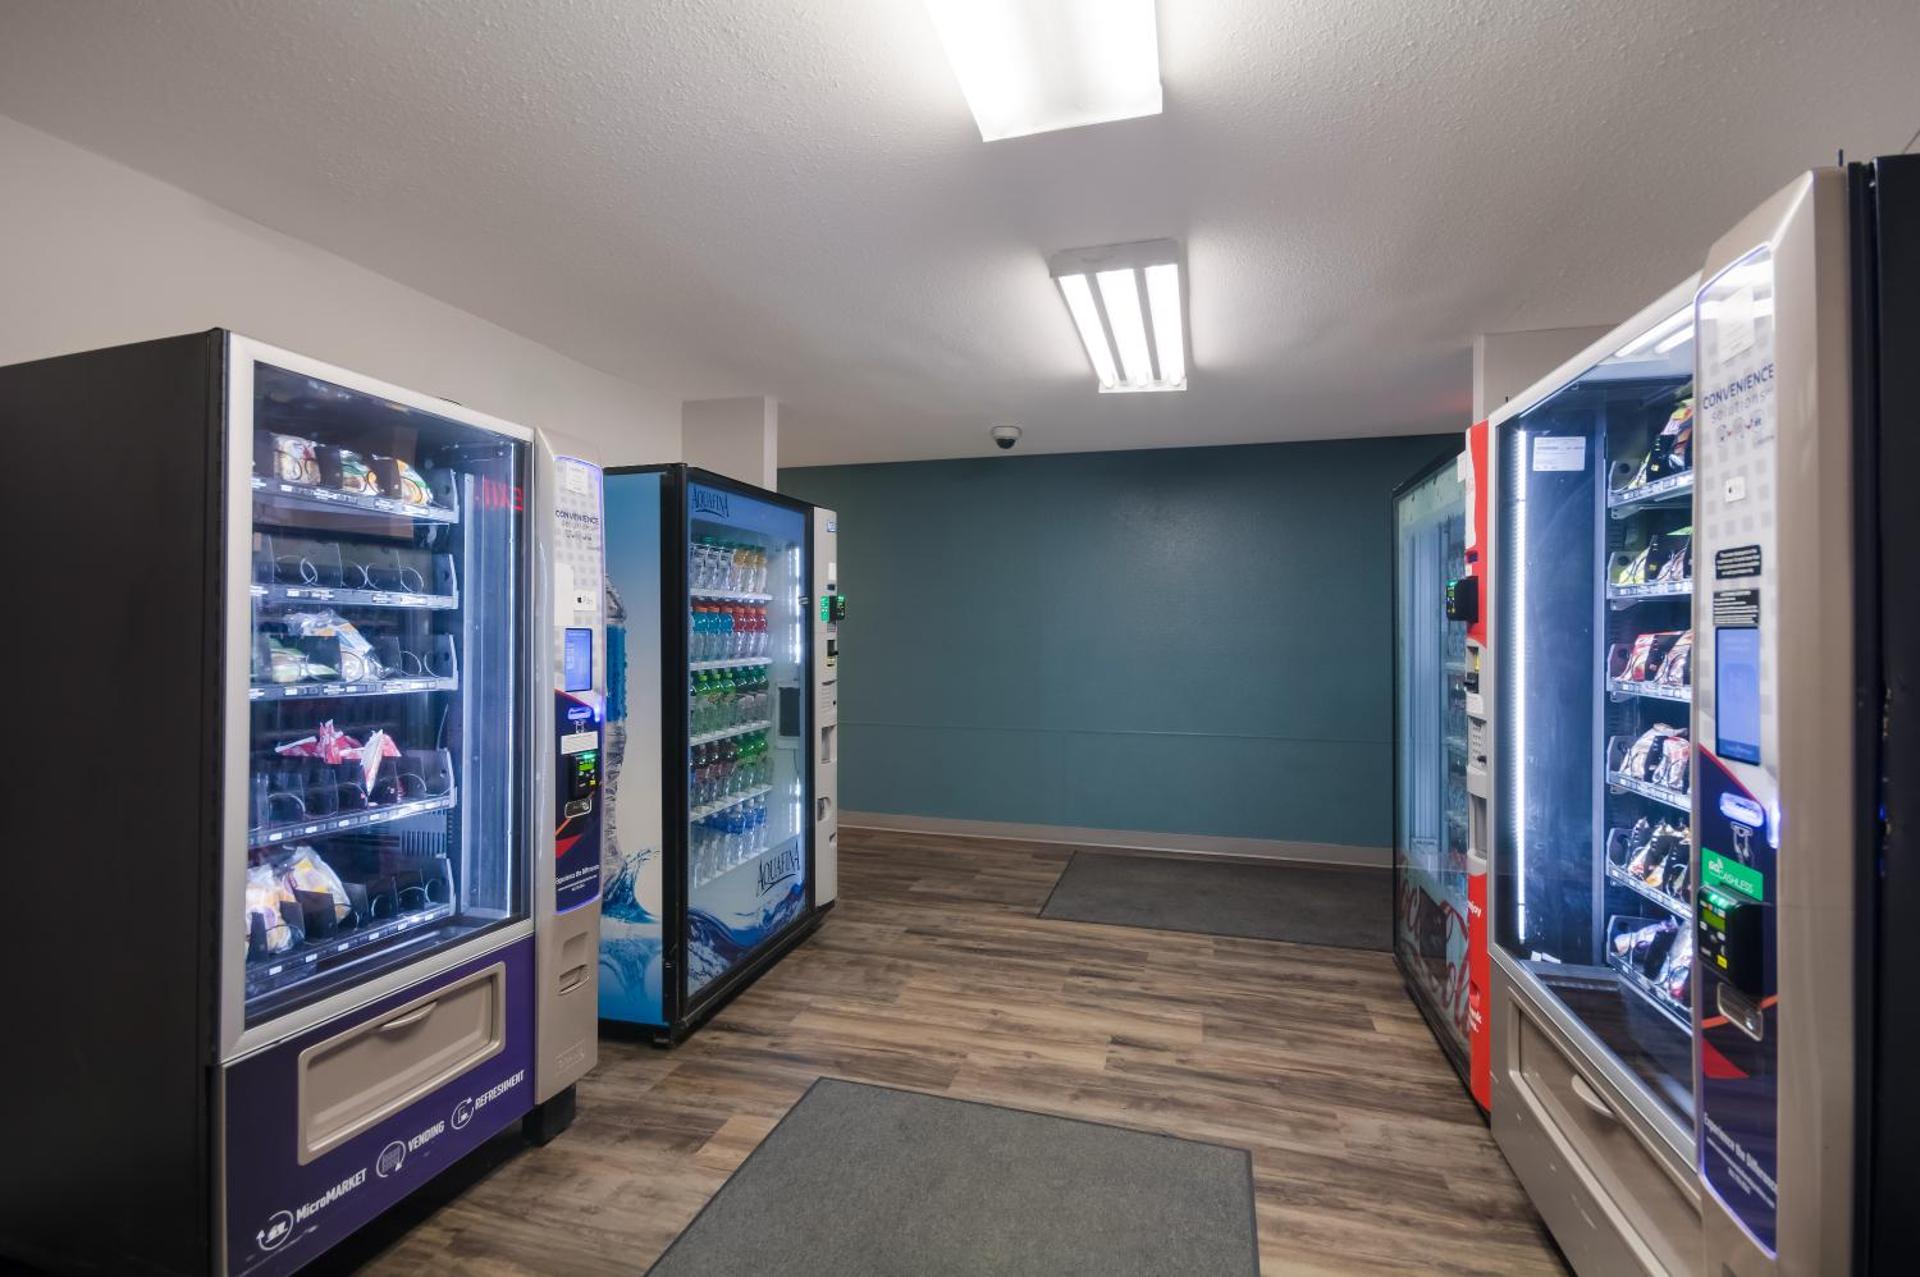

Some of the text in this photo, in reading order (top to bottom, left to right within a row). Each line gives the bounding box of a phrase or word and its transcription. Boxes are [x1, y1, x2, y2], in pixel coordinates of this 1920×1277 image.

[1702, 363, 1774, 410] CONVENIENCE
[555, 509, 599, 525] CONVENIENCE
[691, 484, 730, 518] AQUAFINA
[755, 839, 801, 898] AQUAFINA
[1718, 870, 1754, 893] CASHLESS
[474, 1069, 525, 1110] REFRESHMENT
[408, 1120, 445, 1152] VENDING
[296, 1168, 367, 1223] MicroMARKET
